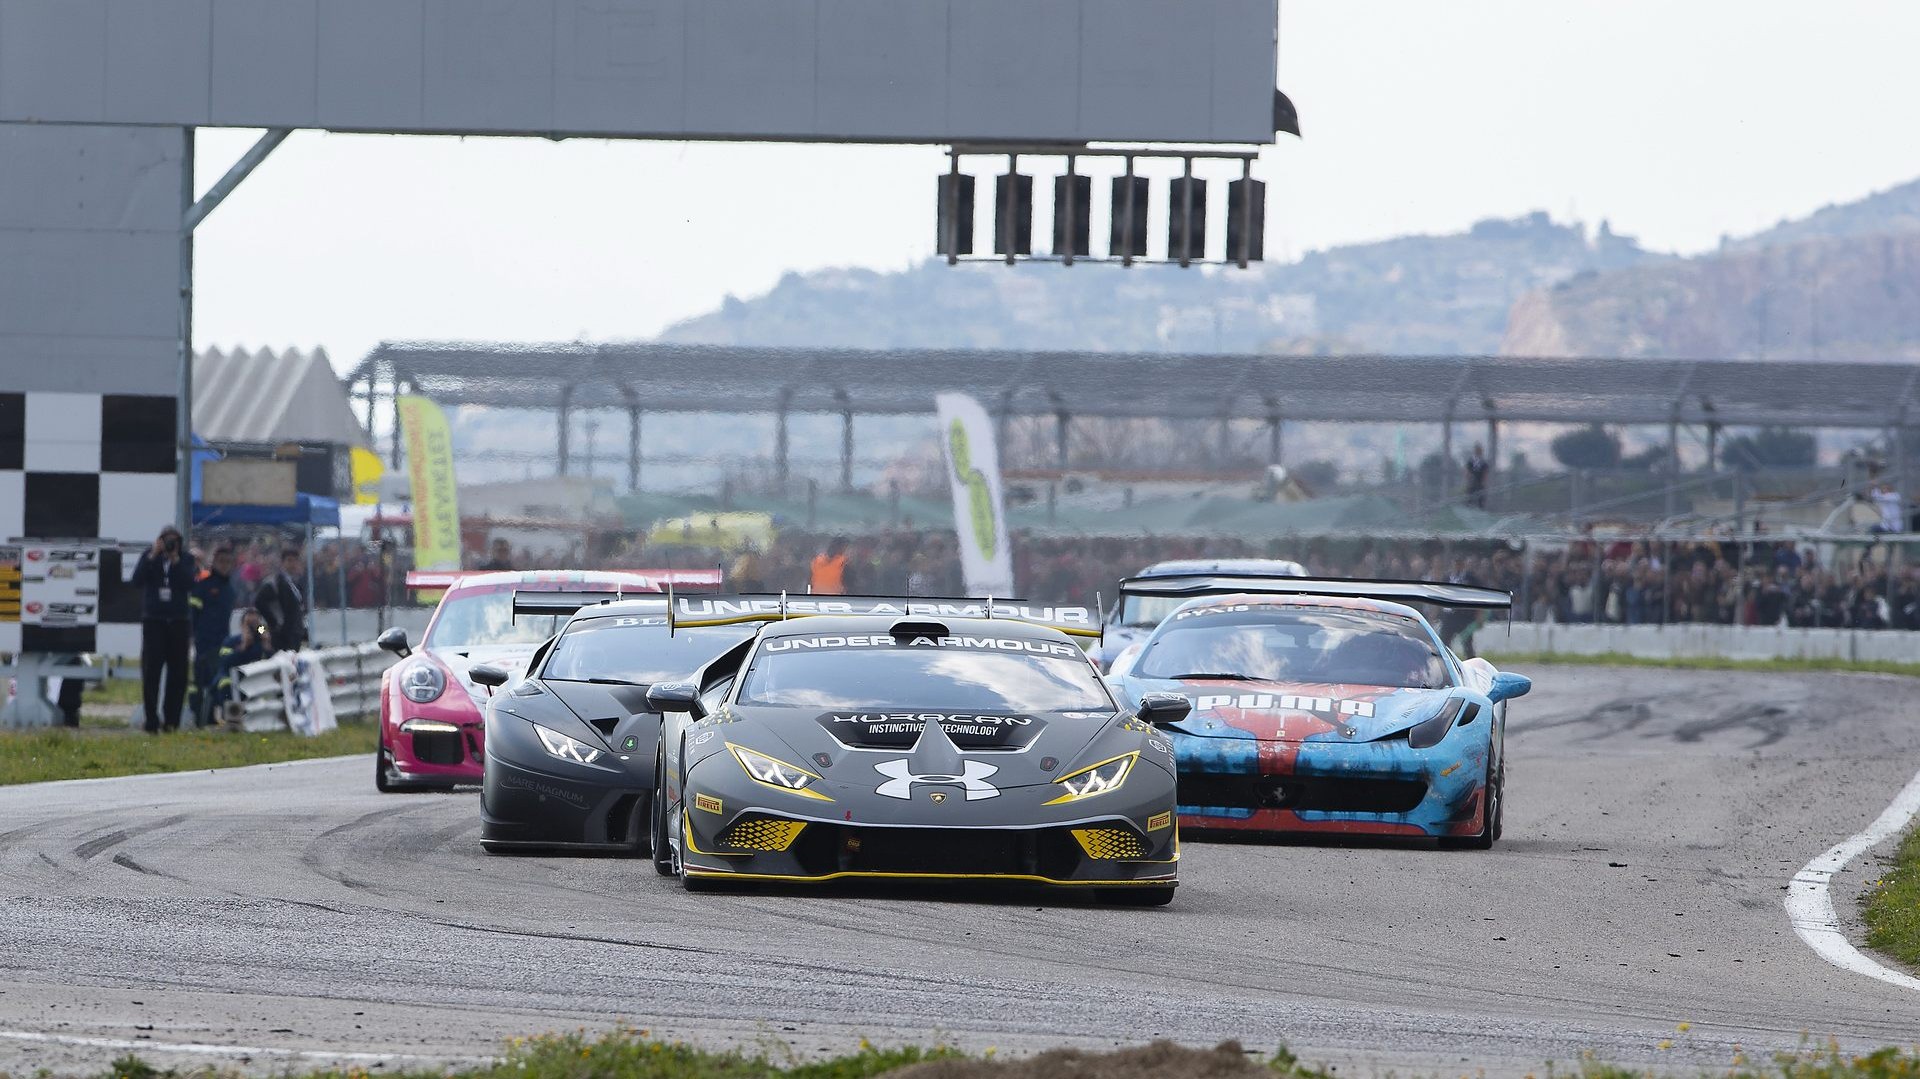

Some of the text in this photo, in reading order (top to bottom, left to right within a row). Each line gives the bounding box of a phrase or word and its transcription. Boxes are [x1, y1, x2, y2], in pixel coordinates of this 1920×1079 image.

[679, 598, 1089, 624] UNDER ARMOUR
[1177, 604, 1417, 628] PYXIS INSURANC
[765, 635, 1077, 657] UNDER ARMOUR
[1196, 694, 1376, 718] PUMA
[868, 723, 999, 736] INSTINCTIVE TECHNOLOGY
[507, 775, 585, 802] MARE MAGNUM
[697, 796, 721, 812] PIRELLI
[1149, 814, 1170, 829] PIRELLI
